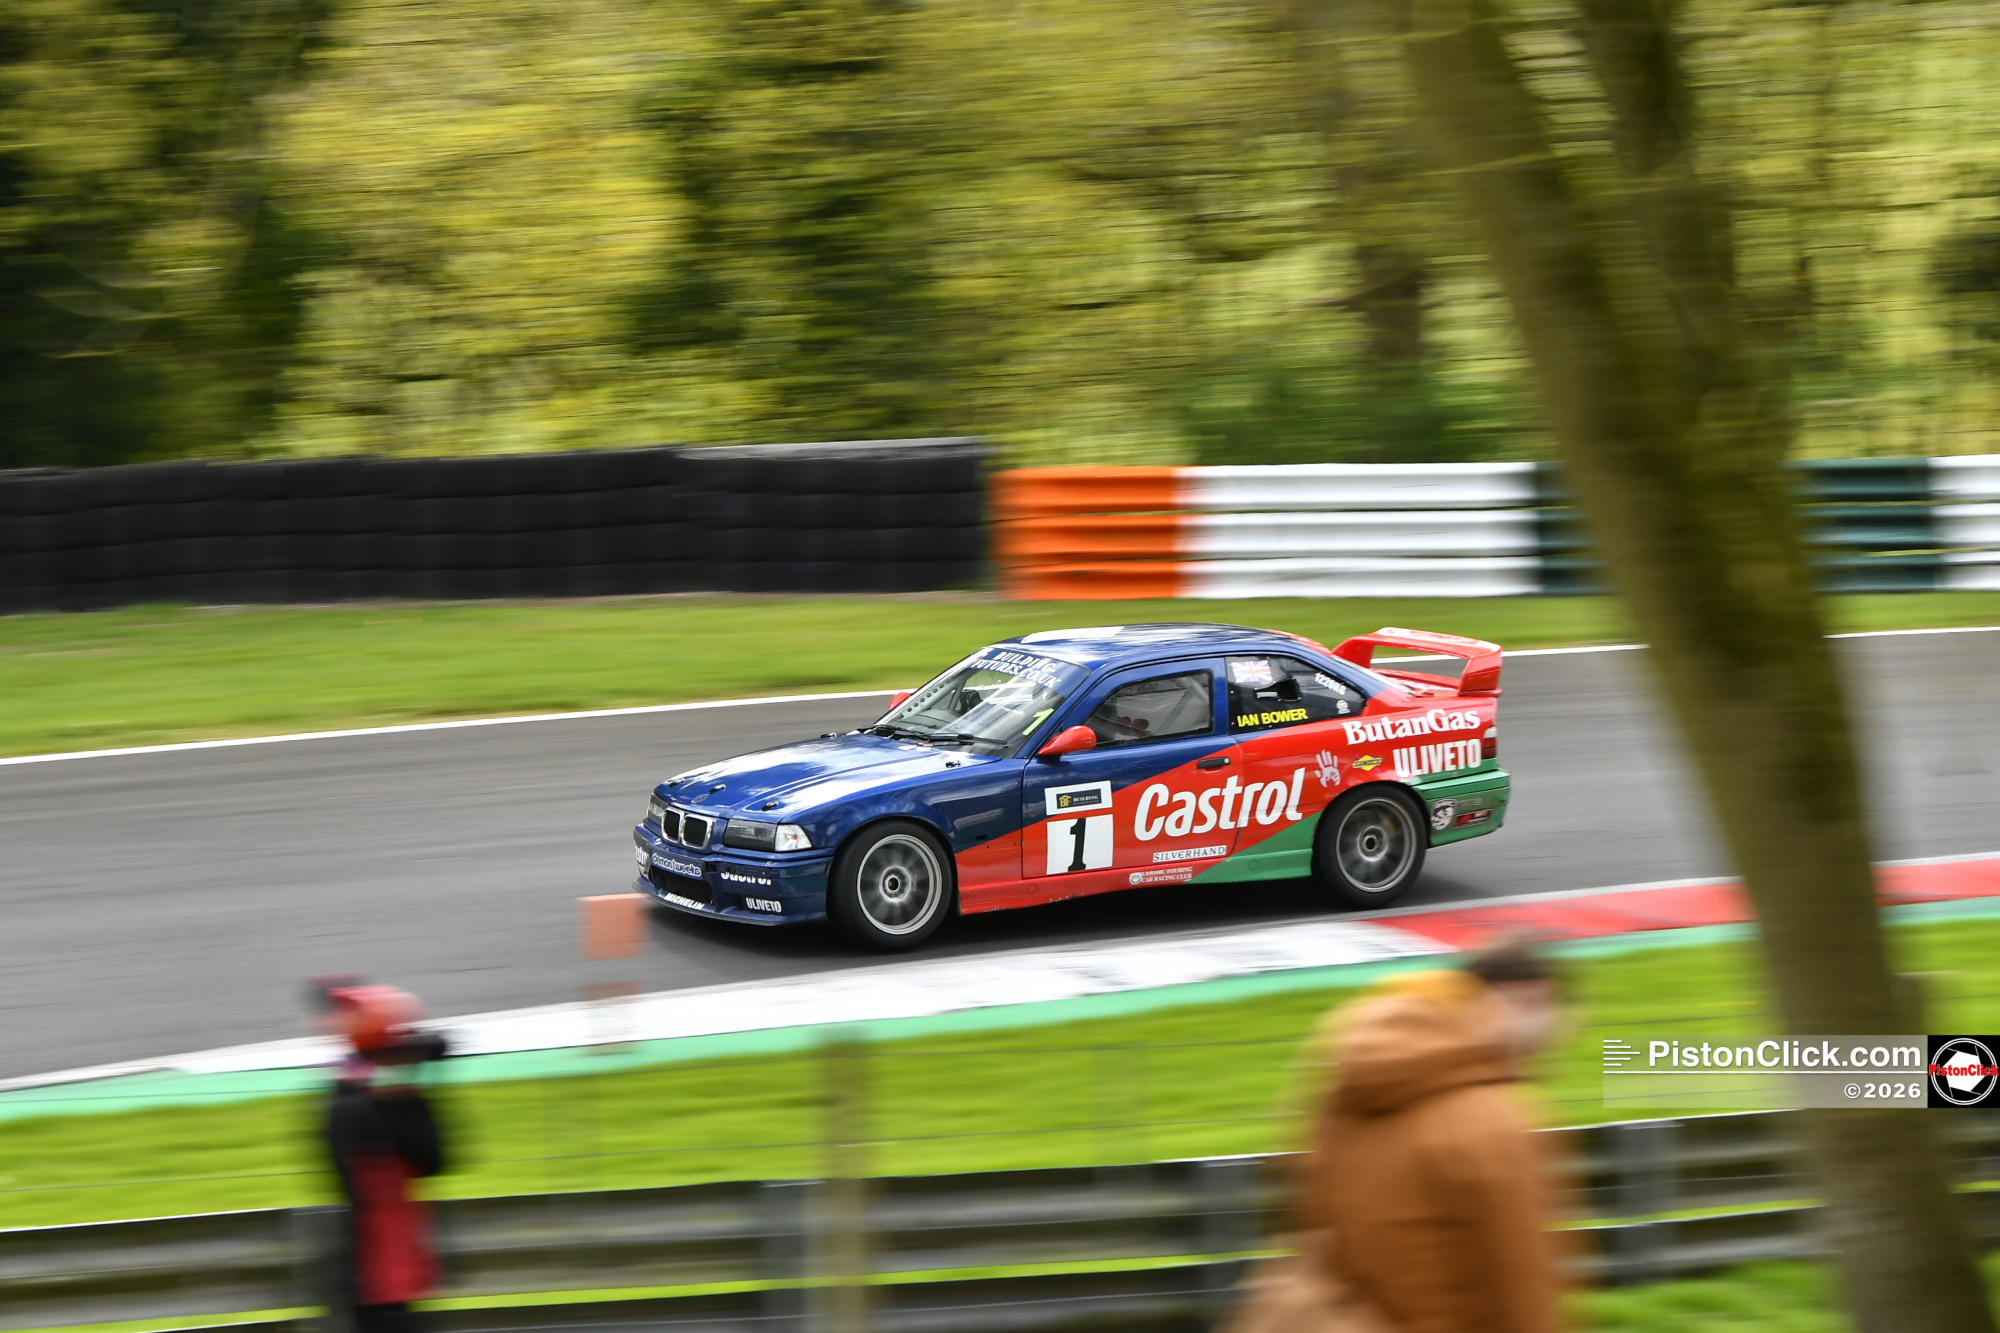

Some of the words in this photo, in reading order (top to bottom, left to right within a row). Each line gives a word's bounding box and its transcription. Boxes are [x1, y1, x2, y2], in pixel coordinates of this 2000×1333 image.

[970, 659, 1061, 688] FUTURES.CO.UK
[1022, 707, 1054, 736] 1
[1237, 713, 1259, 727] IAN
[1261, 708, 1308, 724] BOWER
[1341, 709, 1481, 745] ButanGas
[1392, 738, 1482, 777] ULIVETO
[1134, 767, 1306, 841] Castrol
[1067, 817, 1087, 872] 1
[1153, 846, 1226, 862] SILVERHAND
[664, 892, 705, 910] MICHELIN
[745, 897, 782, 913] ULIVETO
